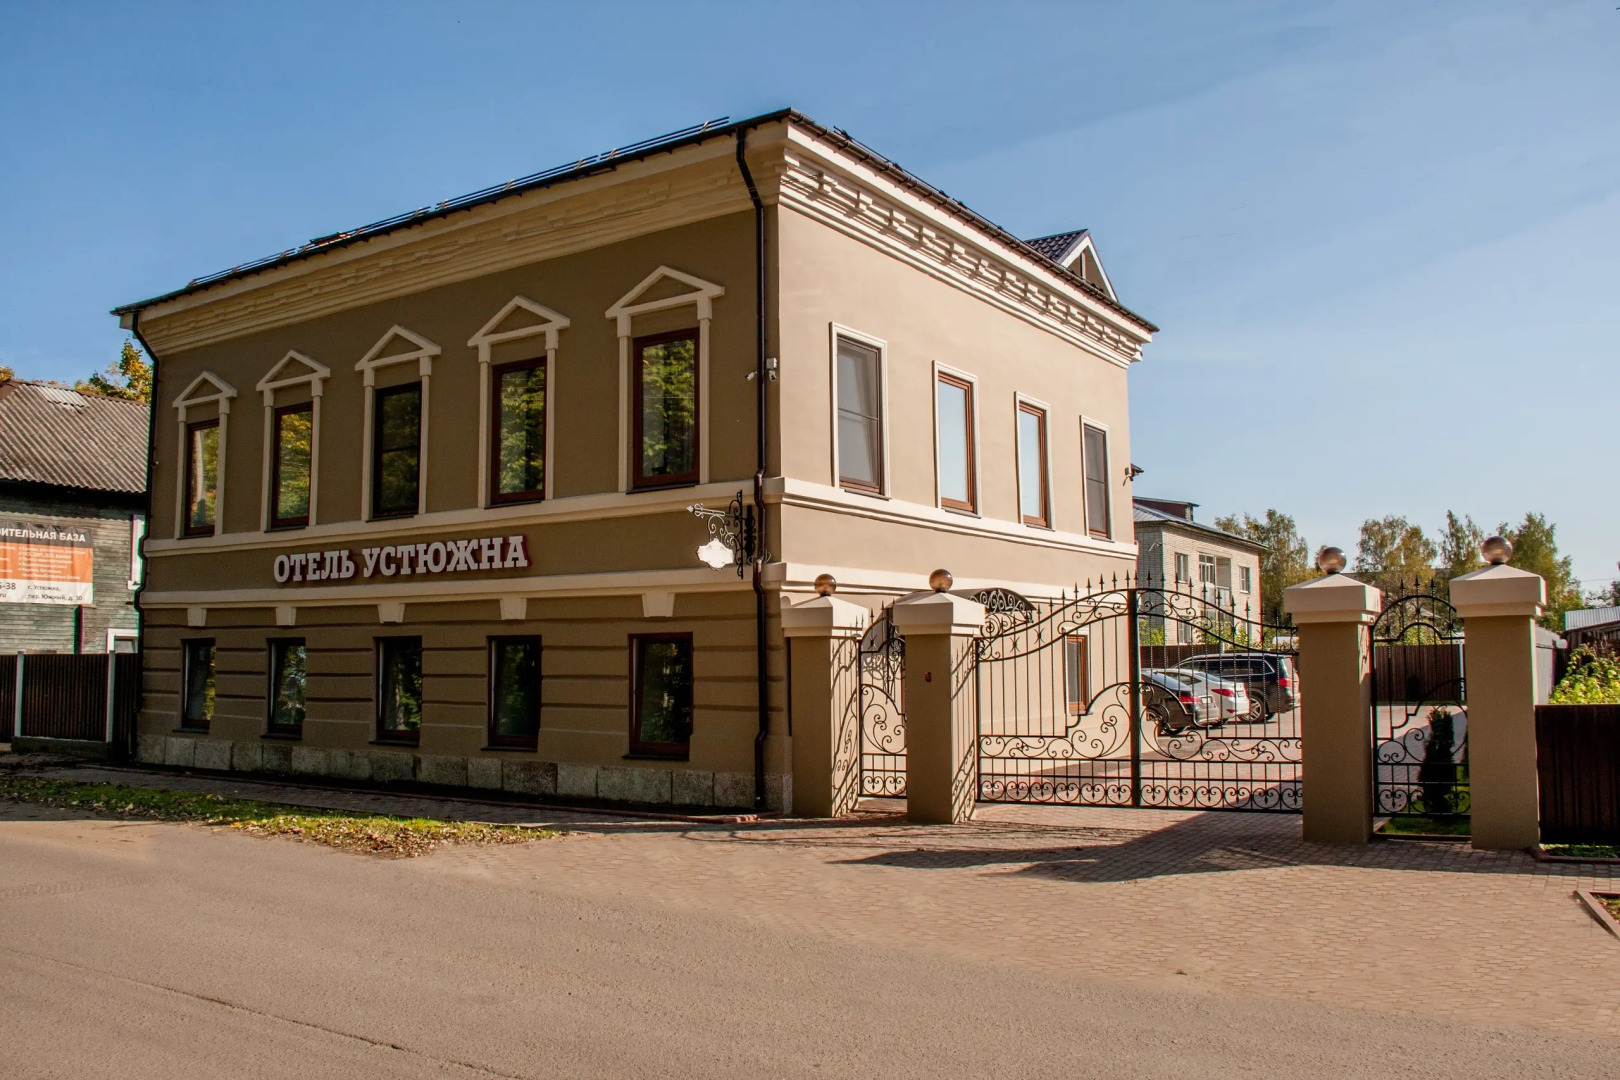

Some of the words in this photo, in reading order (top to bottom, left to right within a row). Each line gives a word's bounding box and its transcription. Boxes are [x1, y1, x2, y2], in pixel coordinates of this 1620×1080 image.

[0, 528, 57, 540] ИТЕЛЬНАЯ
[59, 532, 86, 542] БАЗА
[273, 550, 356, 583] ОТЕЛЬ
[362, 535, 530, 578] УСТЮЖНА
